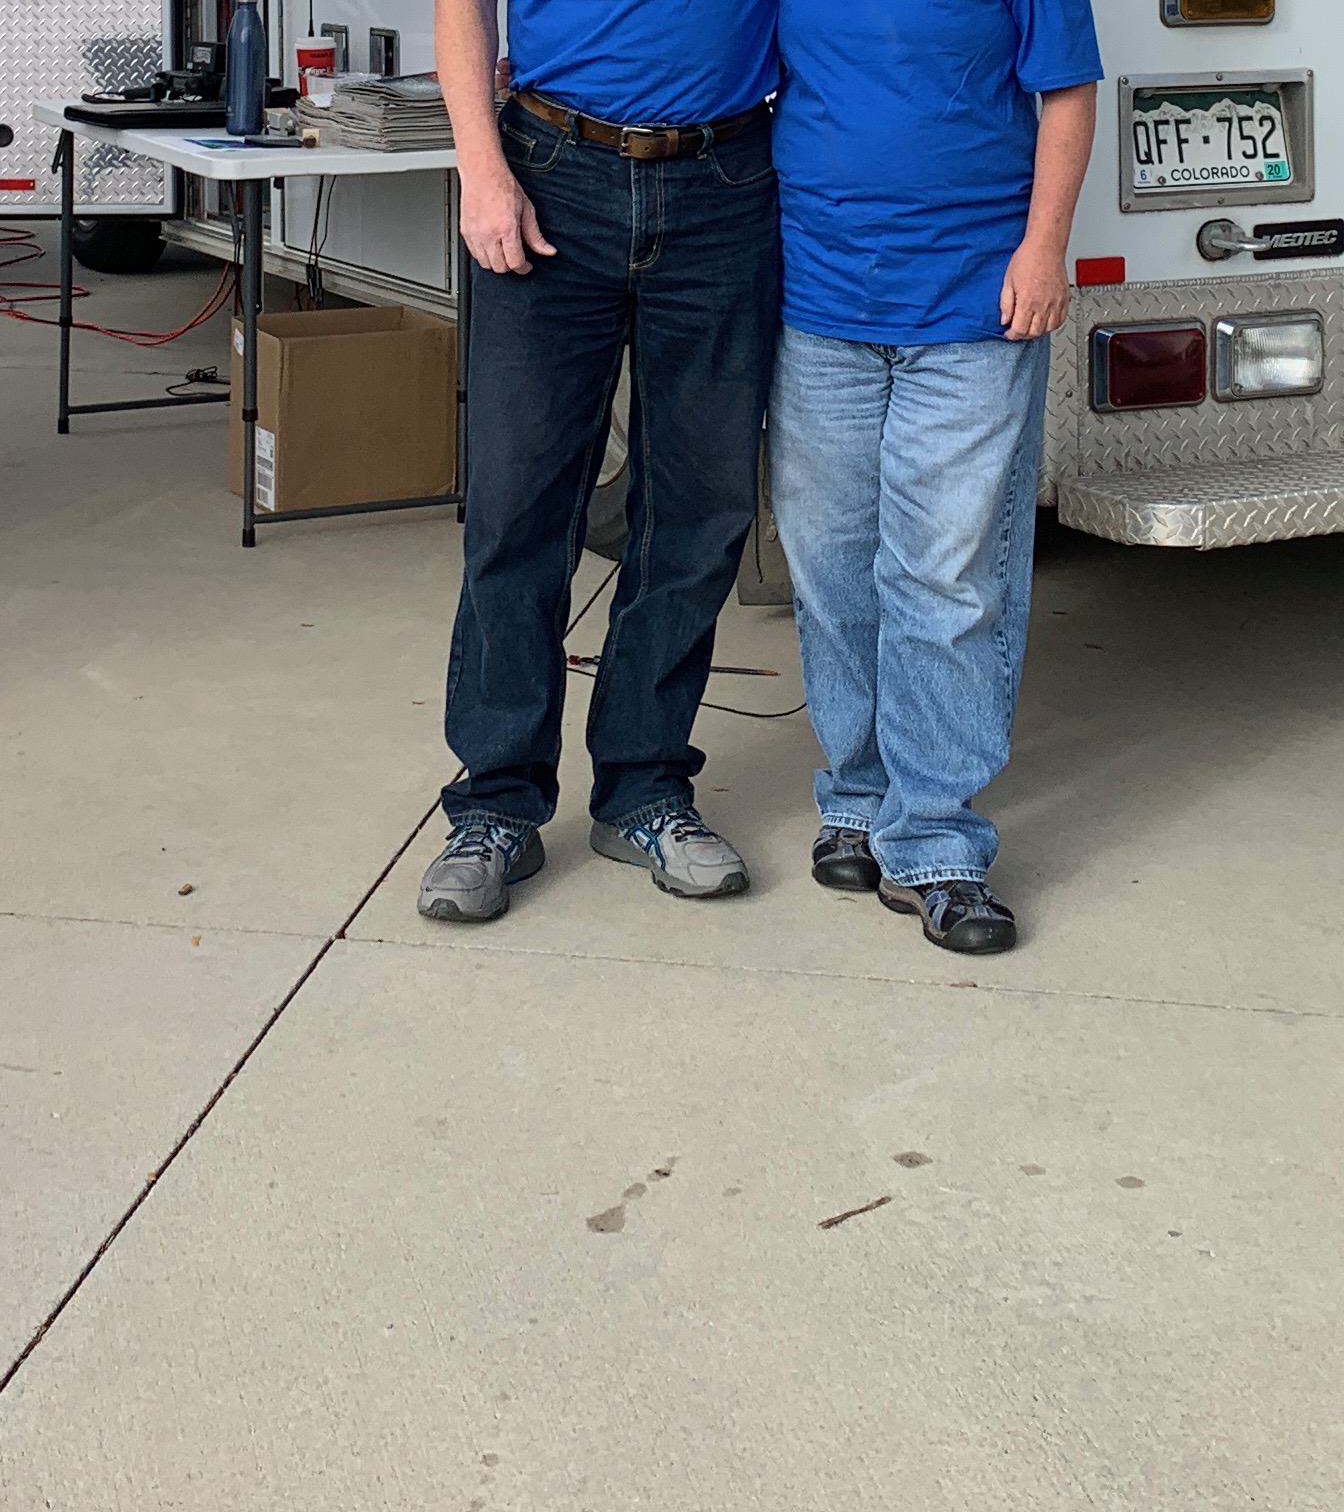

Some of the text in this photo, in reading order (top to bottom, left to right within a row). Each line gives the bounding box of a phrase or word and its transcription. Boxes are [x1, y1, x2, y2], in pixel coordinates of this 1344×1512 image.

[1139, 168, 1148, 181] 6
[1170, 165, 1250, 182] COLORADO
[1267, 163, 1282, 176] 20
